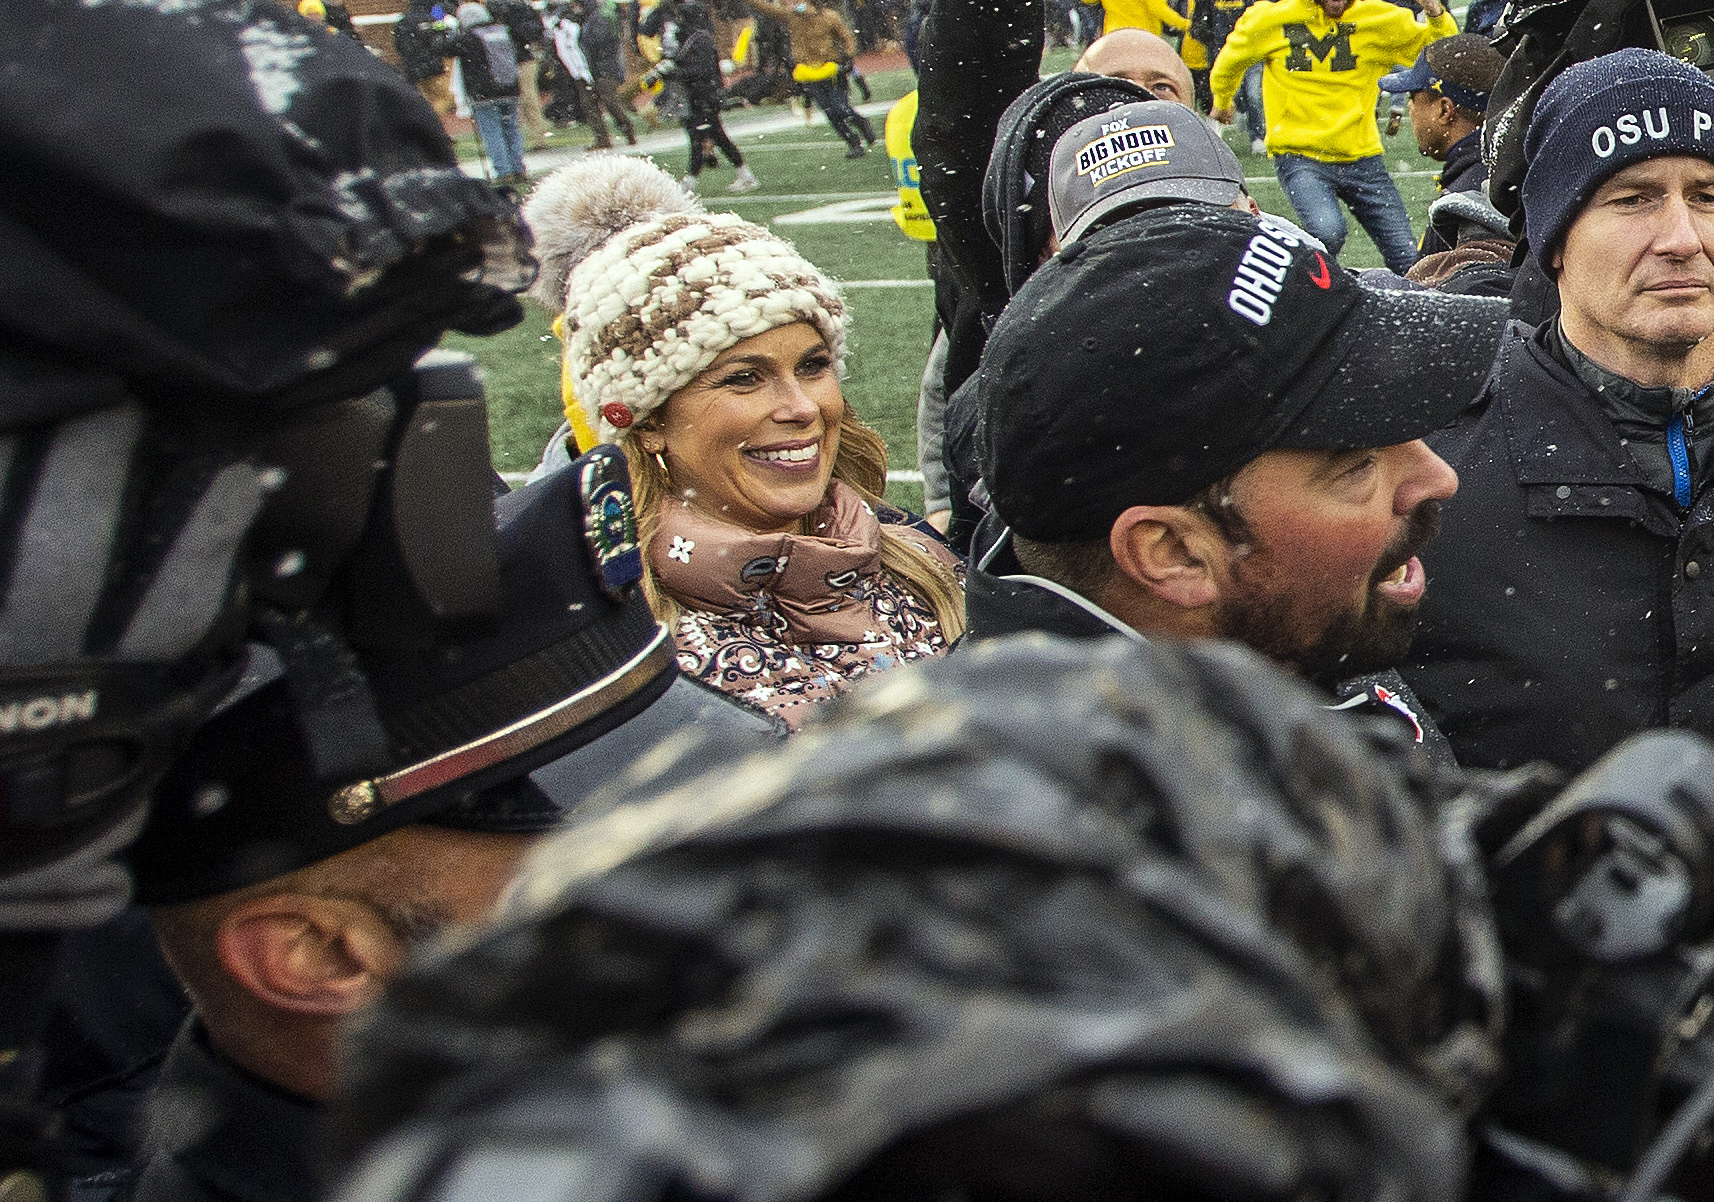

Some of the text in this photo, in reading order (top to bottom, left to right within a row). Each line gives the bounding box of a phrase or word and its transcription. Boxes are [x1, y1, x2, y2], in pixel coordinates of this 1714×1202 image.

[1283, 22, 1358, 72] M
[1080, 129, 1169, 171] BIG NOON
[1101, 118, 1131, 136] FOX
[1592, 107, 1670, 158] OSU
[1089, 148, 1168, 185] KICKOFF
[1228, 234, 1294, 326] OHIO
